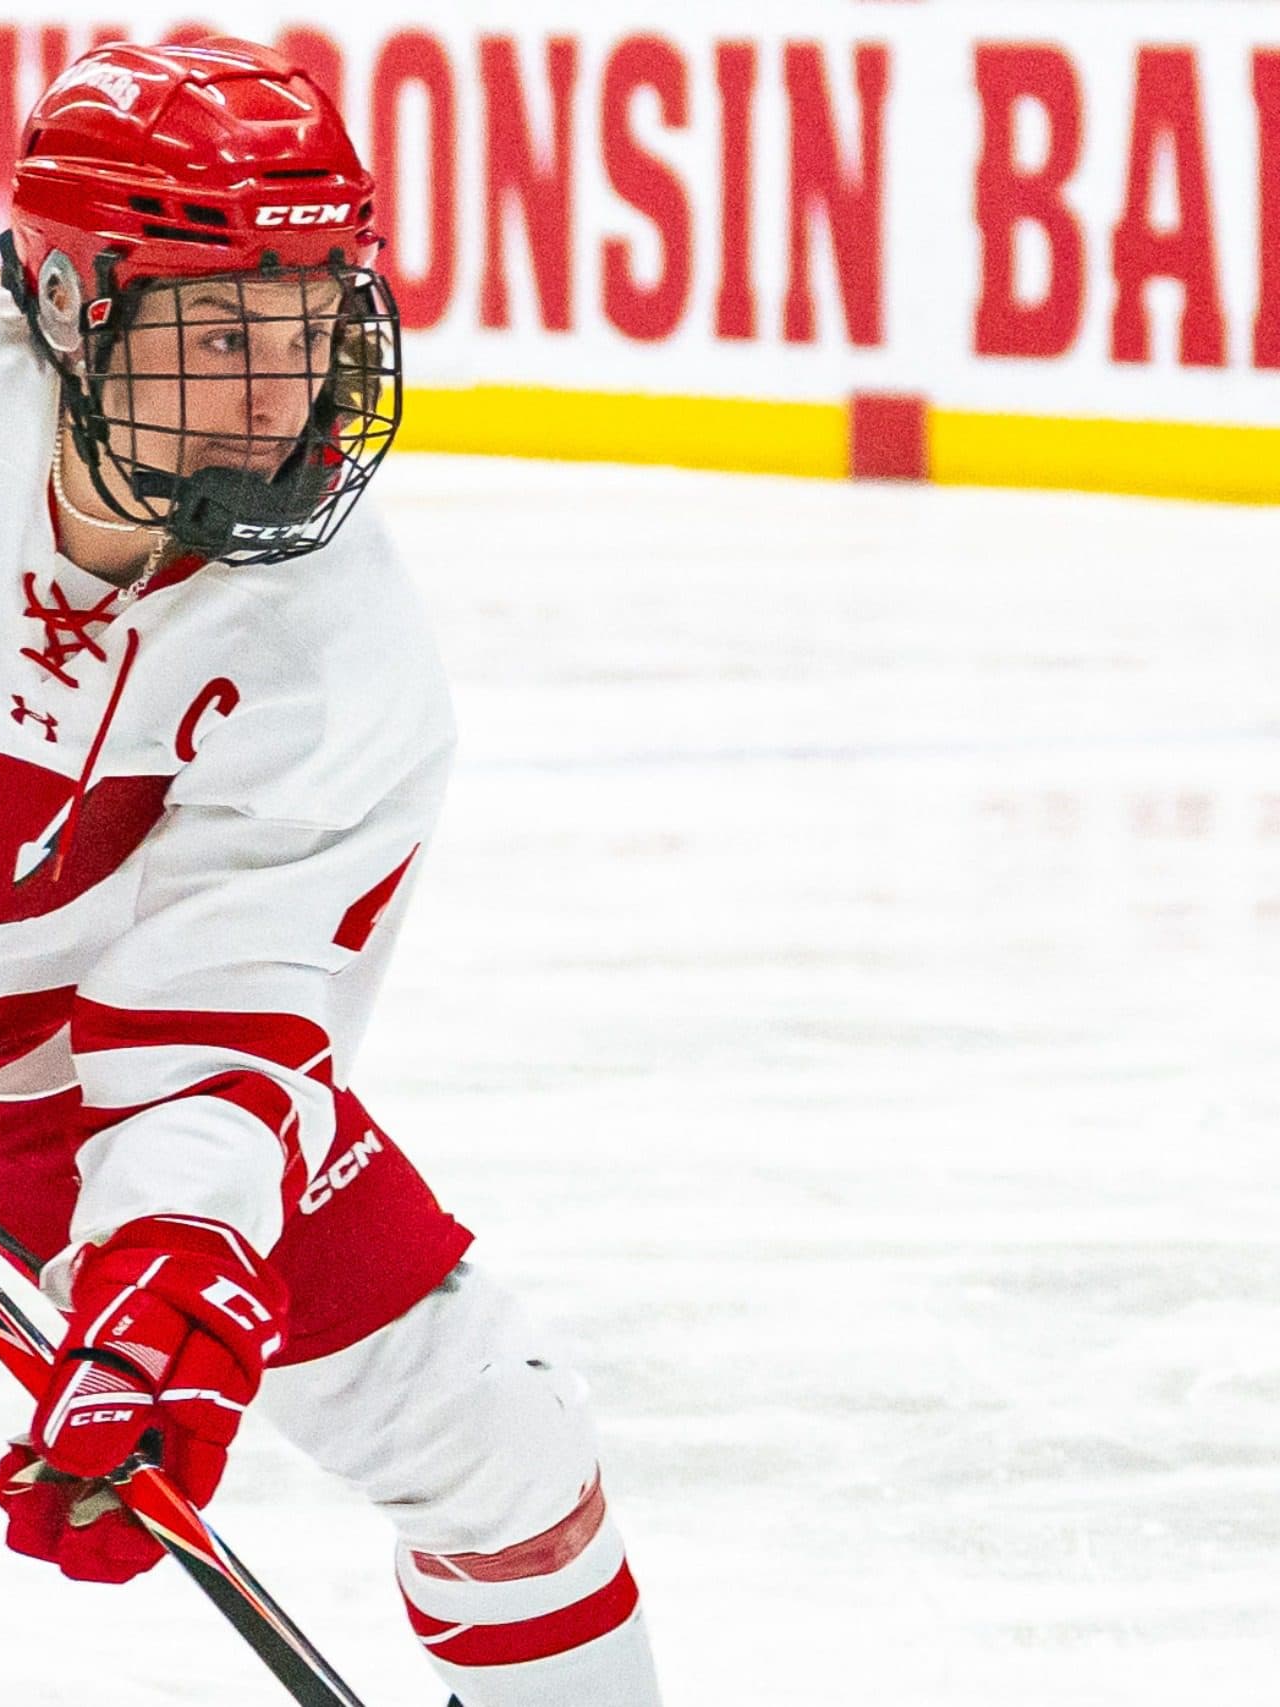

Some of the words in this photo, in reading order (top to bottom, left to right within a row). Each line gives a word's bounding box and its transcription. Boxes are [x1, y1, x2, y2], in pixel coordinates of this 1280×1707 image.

[255, 203, 351, 226] CCM
[972, 40, 1280, 371] BA
[174, 676, 240, 763] C
[297, 1129, 384, 1215] CCM
[70, 1409, 134, 1427] CCM
